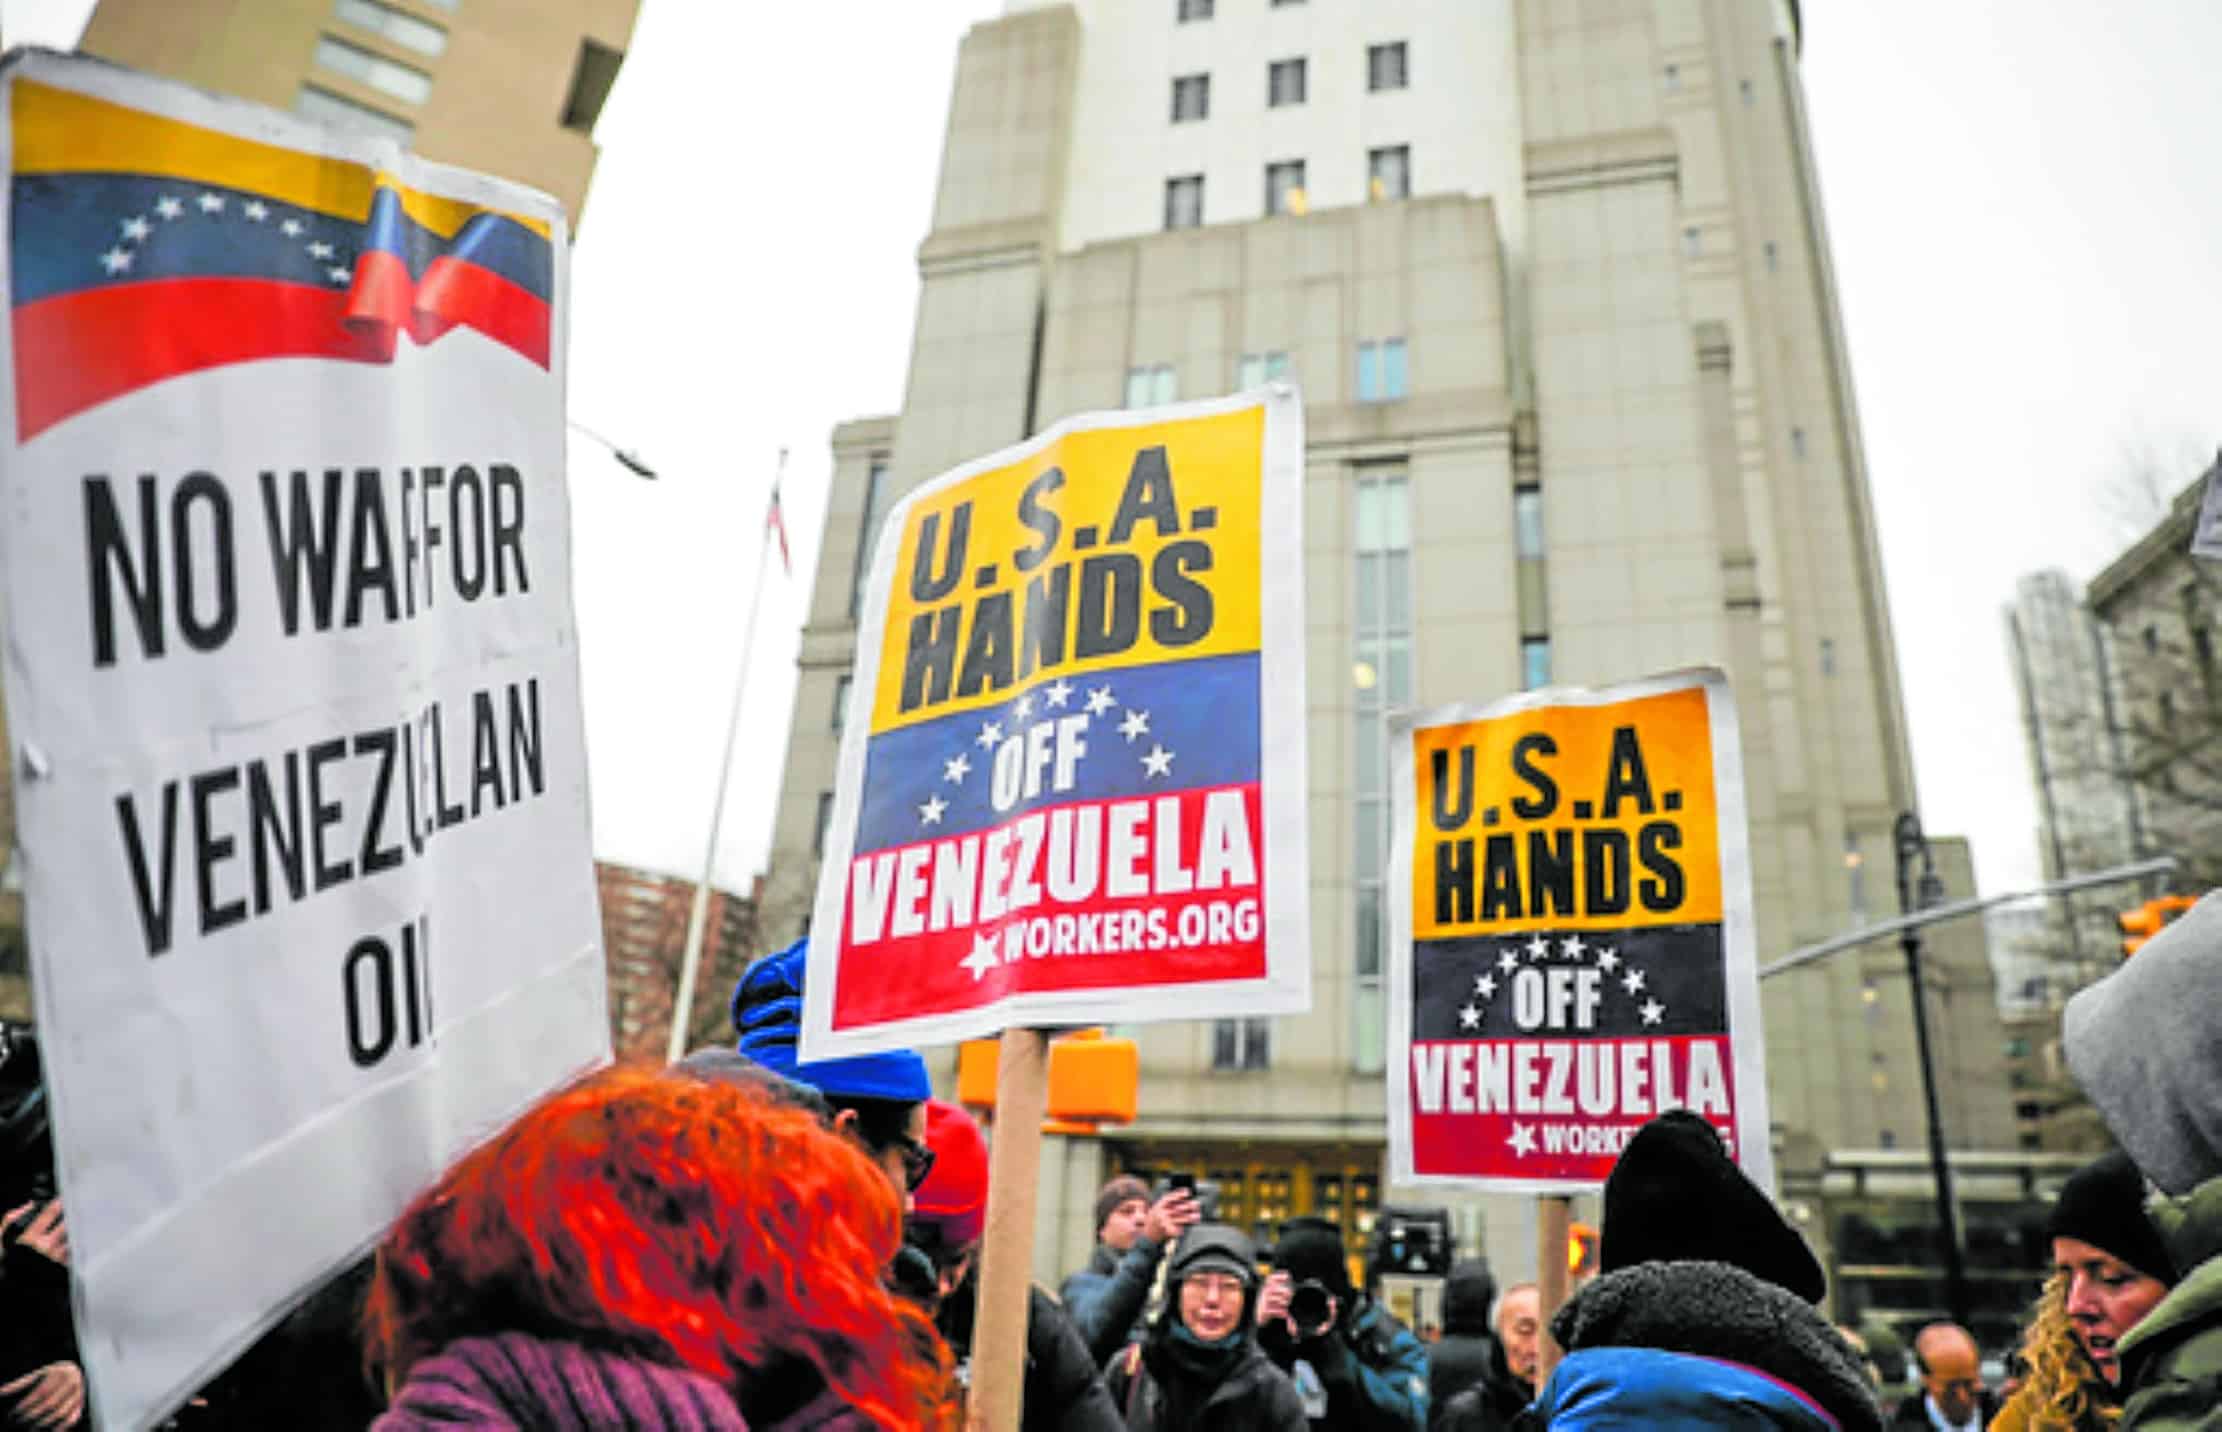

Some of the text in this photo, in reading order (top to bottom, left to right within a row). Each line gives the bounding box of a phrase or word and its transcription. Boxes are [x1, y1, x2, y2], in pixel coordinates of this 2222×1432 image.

[81, 470, 238, 668] NO
[421, 463, 530, 609] FOR
[910, 444, 1218, 603] U.S.A.
[899, 540, 1214, 714] HANDS
[990, 713, 1089, 811] OFF
[1431, 725, 1683, 832] U.S.A.
[850, 790, 1257, 946] VENEZUELA
[1435, 821, 1686, 924] HANDS
[1001, 900, 1259, 962] WORKERS.ORG
[341, 914, 433, 1070] OI
[1511, 969, 1602, 1030] OFF
[1413, 1040, 1731, 1116] VENEZUELA
